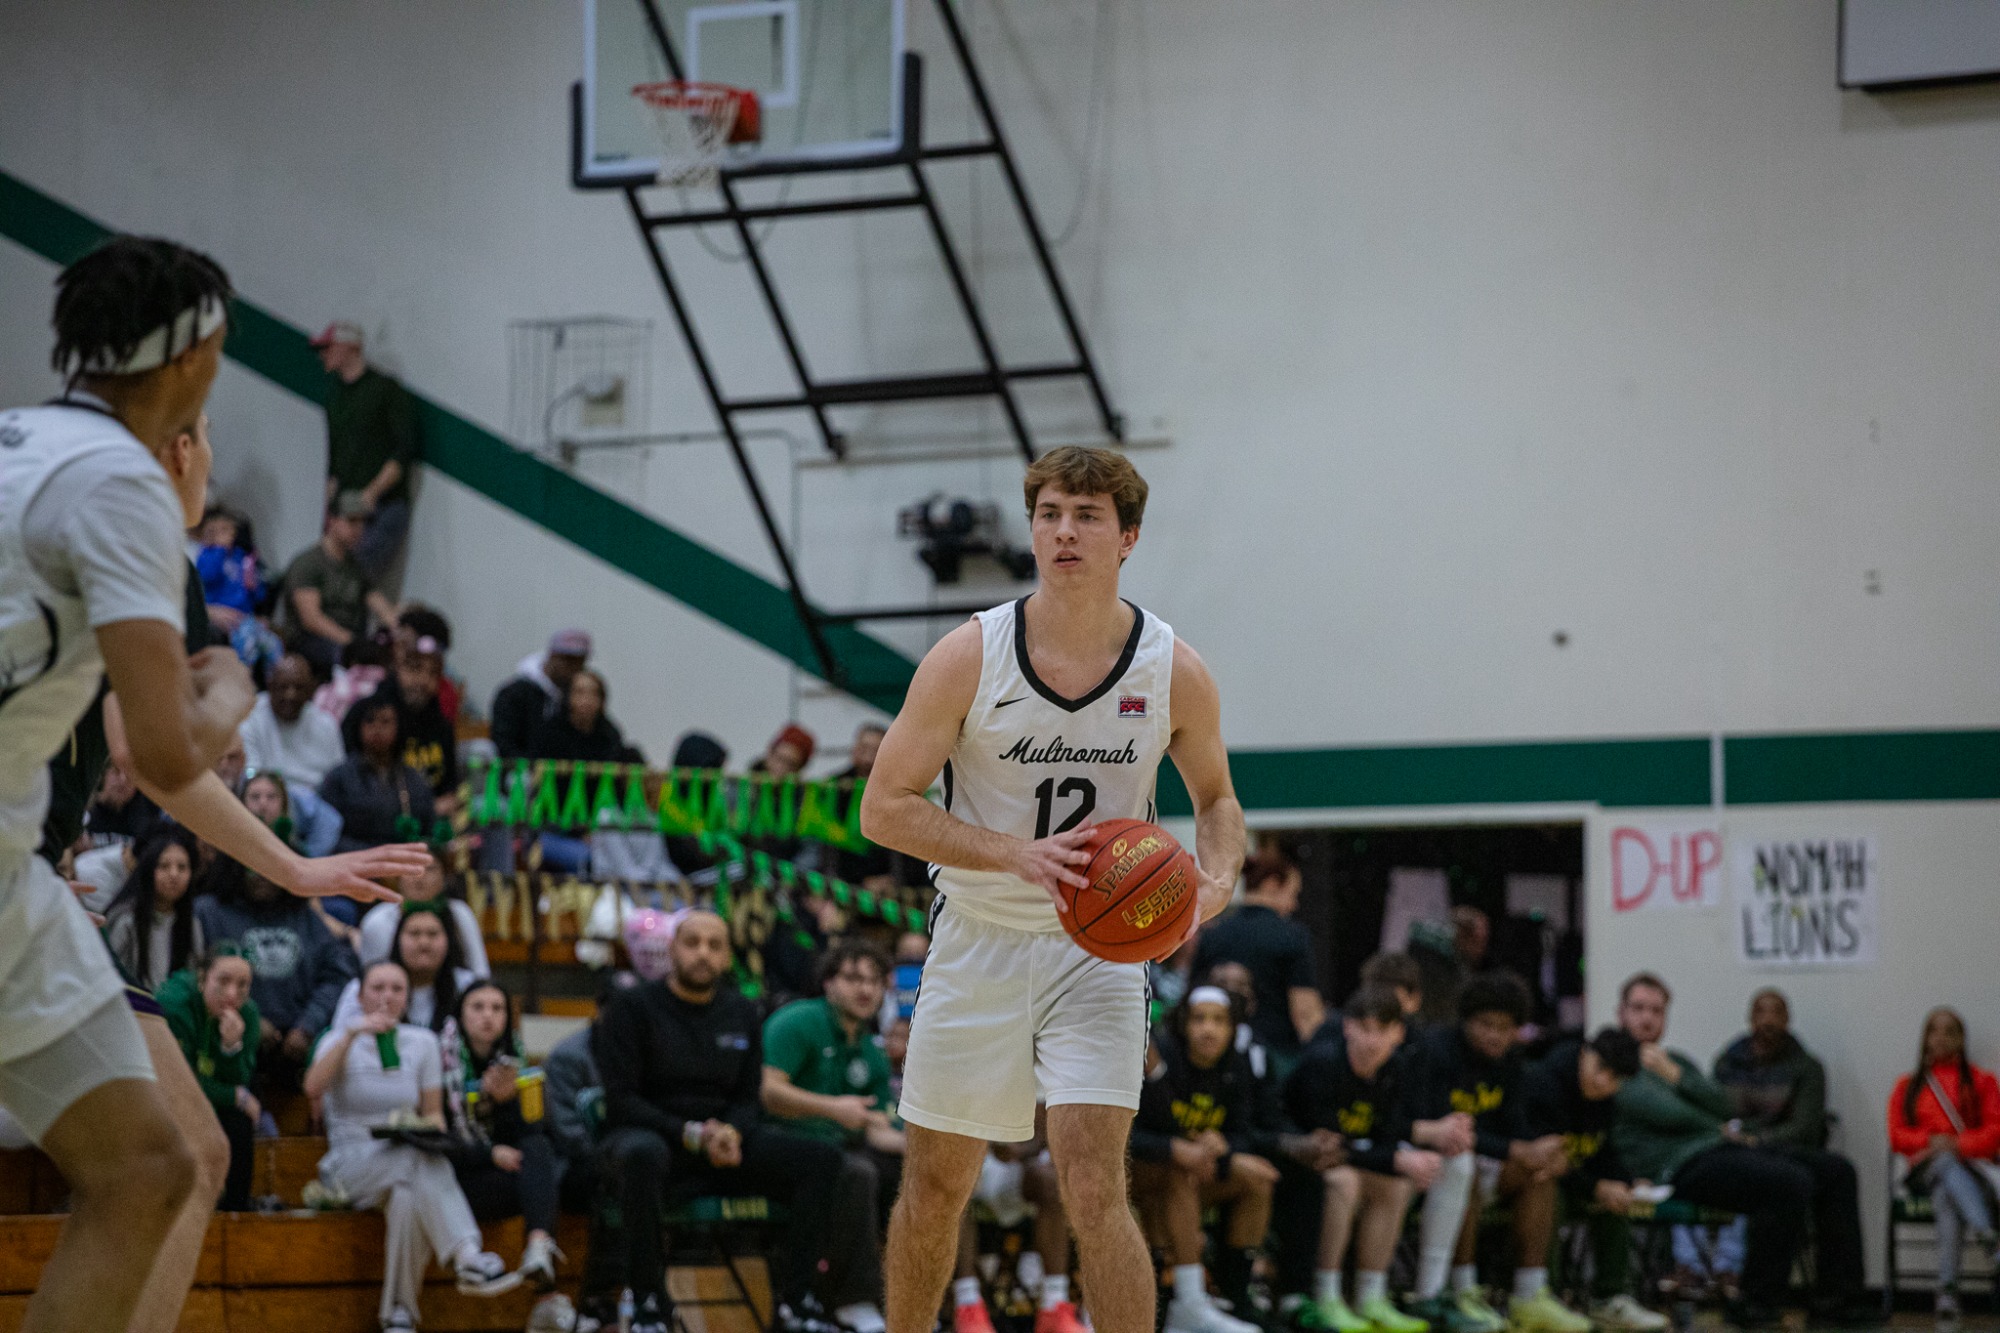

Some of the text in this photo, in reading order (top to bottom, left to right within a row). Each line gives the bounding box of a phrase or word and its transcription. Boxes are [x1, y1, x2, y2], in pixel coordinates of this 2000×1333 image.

[1121, 702, 1145, 711] CCC
[999, 735, 1138, 765] Multnomah
[1034, 777, 1096, 840] 12
[1610, 826, 1724, 912] D-UP
[1742, 899, 1860, 960] LIONS
